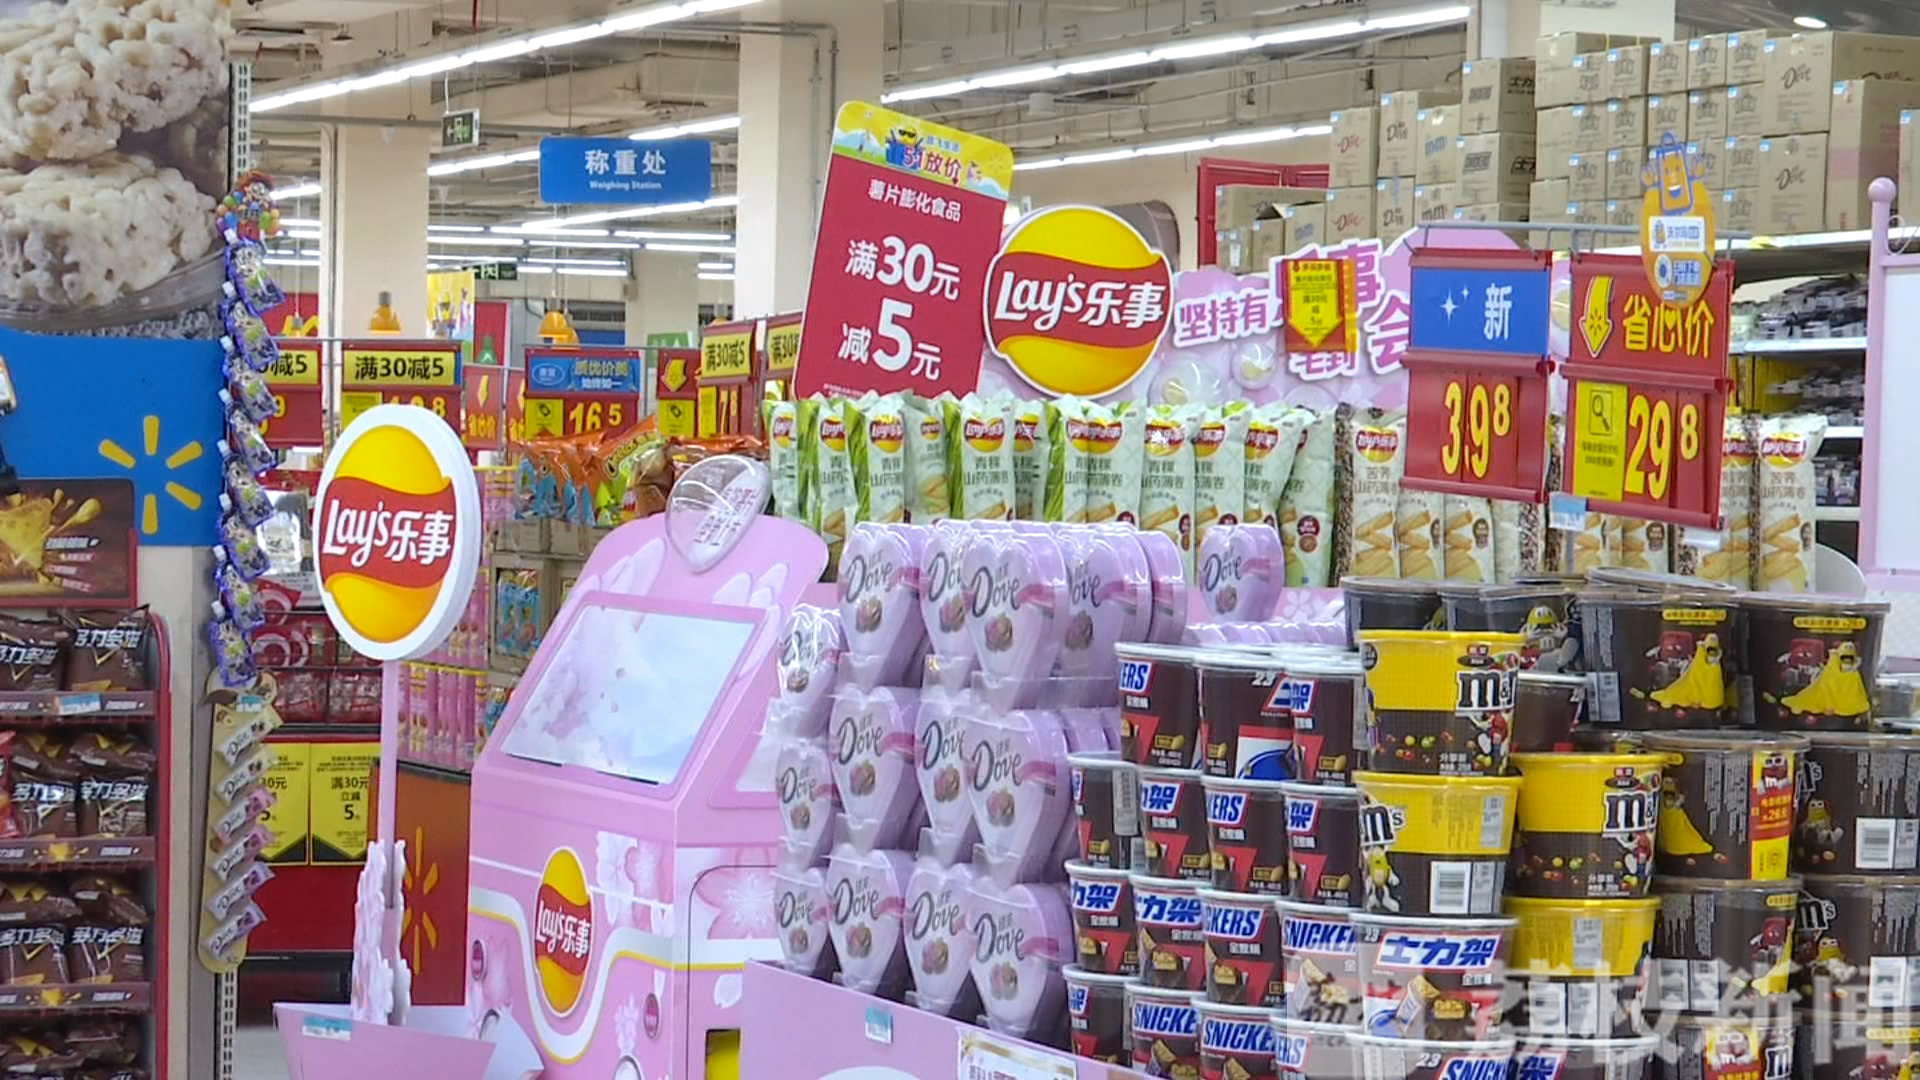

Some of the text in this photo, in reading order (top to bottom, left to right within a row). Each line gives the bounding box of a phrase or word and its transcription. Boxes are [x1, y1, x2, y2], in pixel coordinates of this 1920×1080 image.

[585, 149, 667, 176] 称重处
[590, 181, 661, 191] Weighing Station
[868, 179, 962, 222] 薯片膨化食品
[845, 235, 961, 300] 满30元
[1484, 282, 1513, 341] 新
[1623, 294, 1715, 358] 省心价
[706, 340, 745, 371] 满30减5
[838, 297, 942, 381] 减5元
[355, 355, 445, 380] 满30减5
[845, 554, 892, 604] Dove
[970, 566, 1022, 618] Dove
[1067, 563, 1101, 609] ove
[1203, 553, 1243, 592] Dove
[837, 717, 883, 765] Dove
[781, 767, 816, 805] Dove
[971, 740, 1023, 792] Dove
[780, 891, 813, 928] Dove
[833, 877, 879, 925] Dove
[912, 891, 960, 940] Dove
[974, 912, 1025, 964] Dove
[1380, 934, 1498, 967] 士力架
